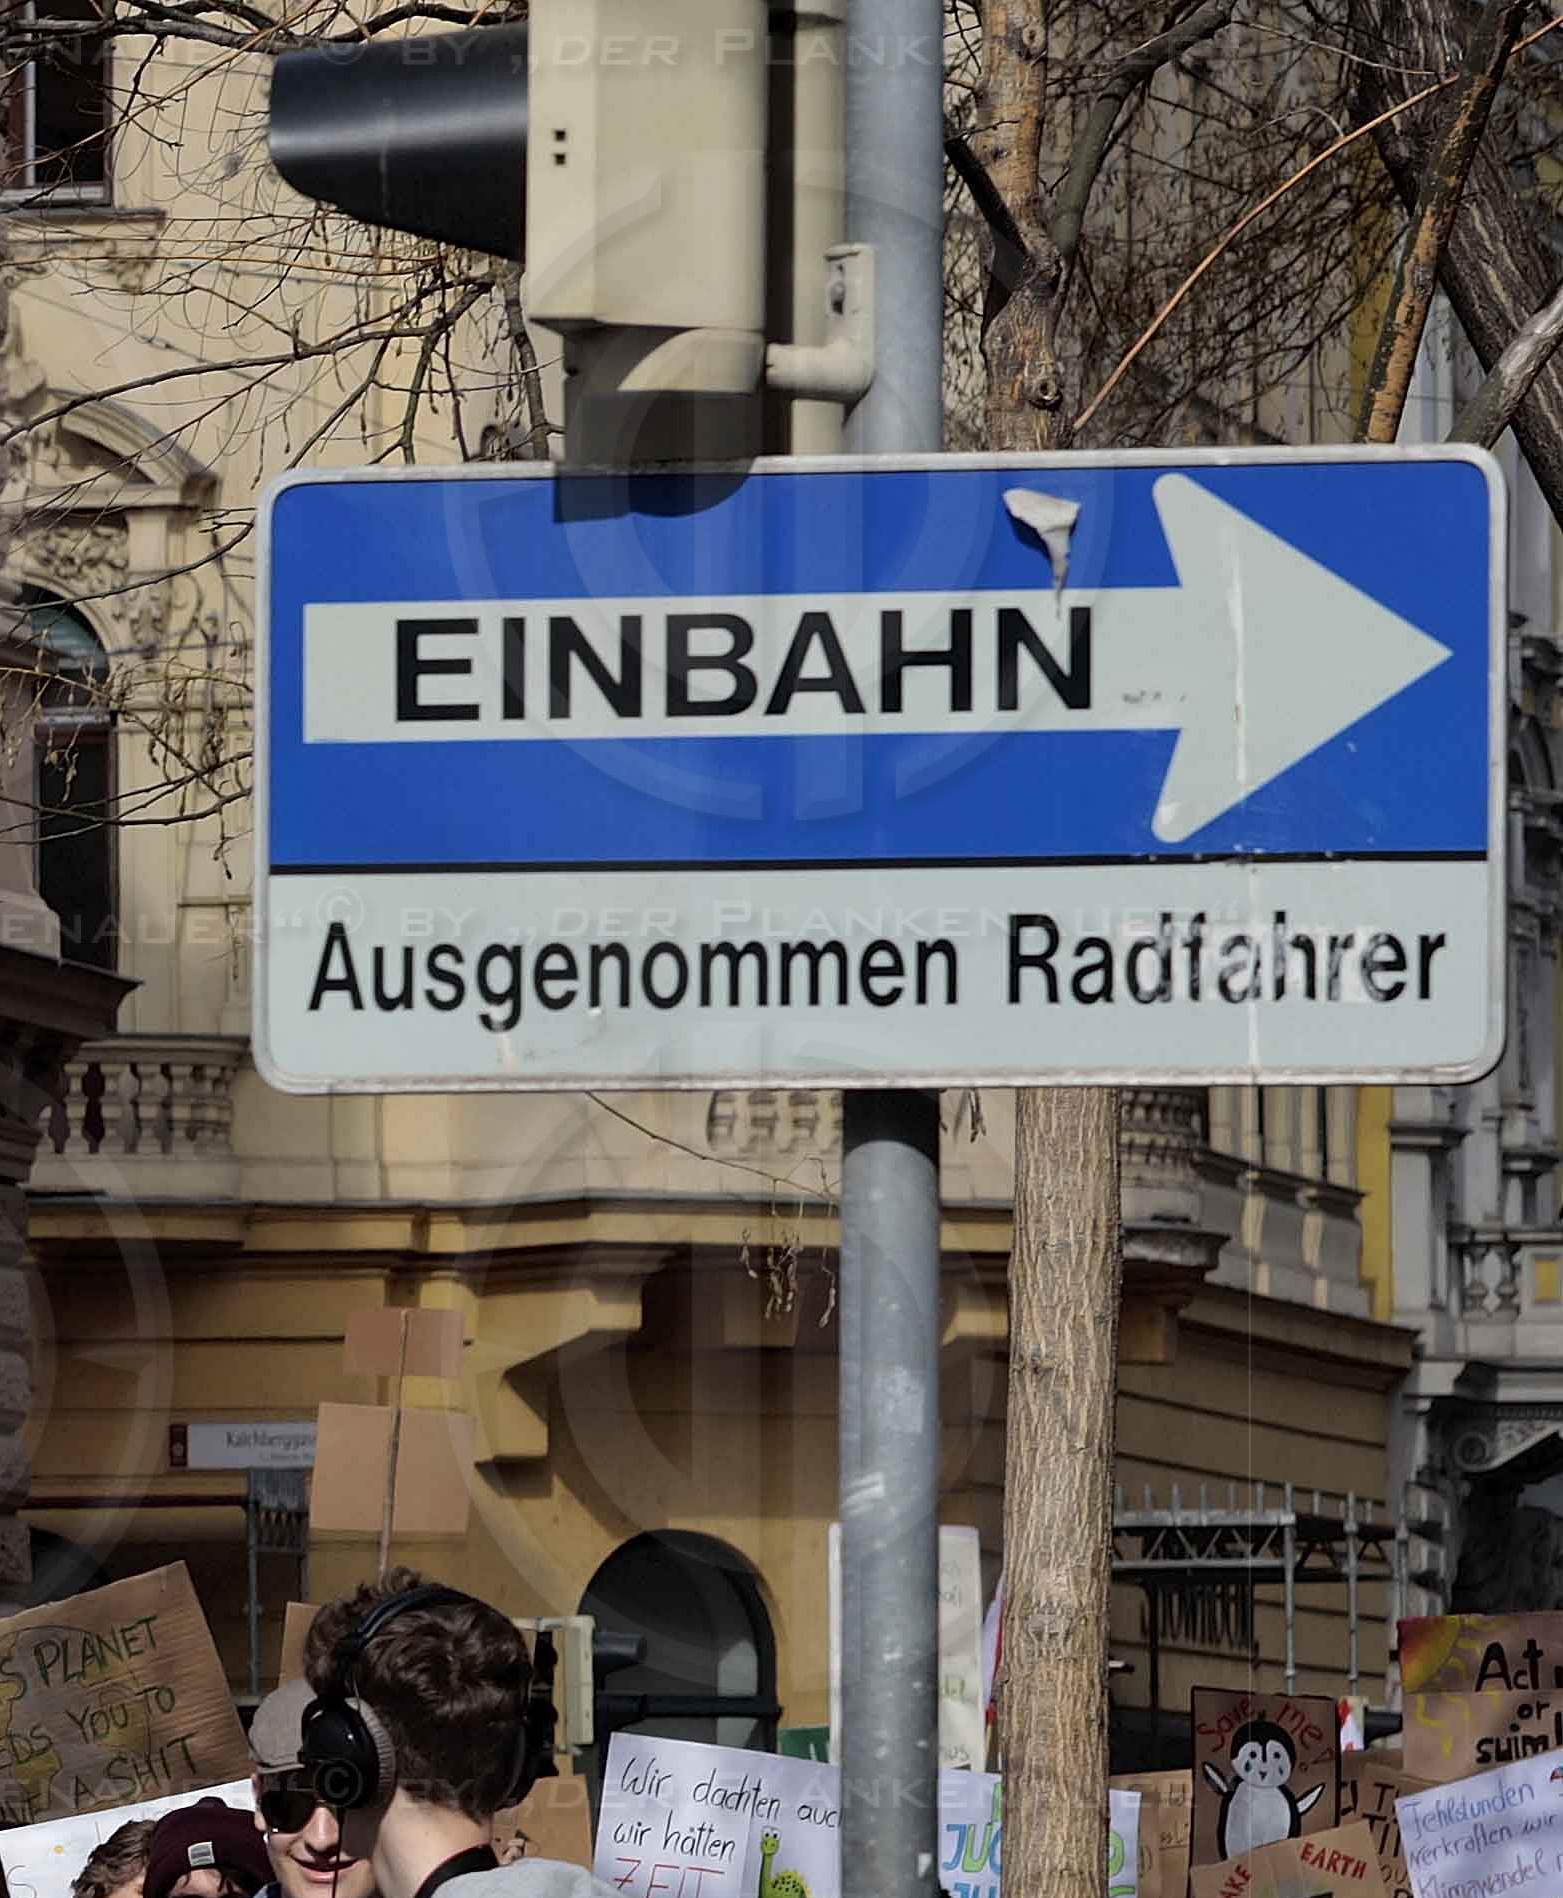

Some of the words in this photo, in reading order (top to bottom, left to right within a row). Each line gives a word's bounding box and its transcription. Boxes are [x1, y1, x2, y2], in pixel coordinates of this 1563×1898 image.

[395, 606, 1093, 723] EINBAHN
[309, 914, 961, 1033] Ausgenommen
[1006, 909, 1447, 1006] Radfahrer
[32, 1615, 159, 1686] PLANET
[1475, 1638, 1544, 1693] Act
[66, 1701, 130, 1746] YOU
[134, 1685, 176, 1719] TO
[1517, 1702, 1550, 1721] or
[72, 1774, 97, 1809] A
[102, 1732, 201, 1800] SHIT
[620, 1755, 673, 1800] Wir
[693, 1767, 783, 1819] dachten
[613, 1823, 652, 1849] wir
[662, 1809, 738, 1861] hätten
[1300, 1841, 1368, 1880] EARTH
